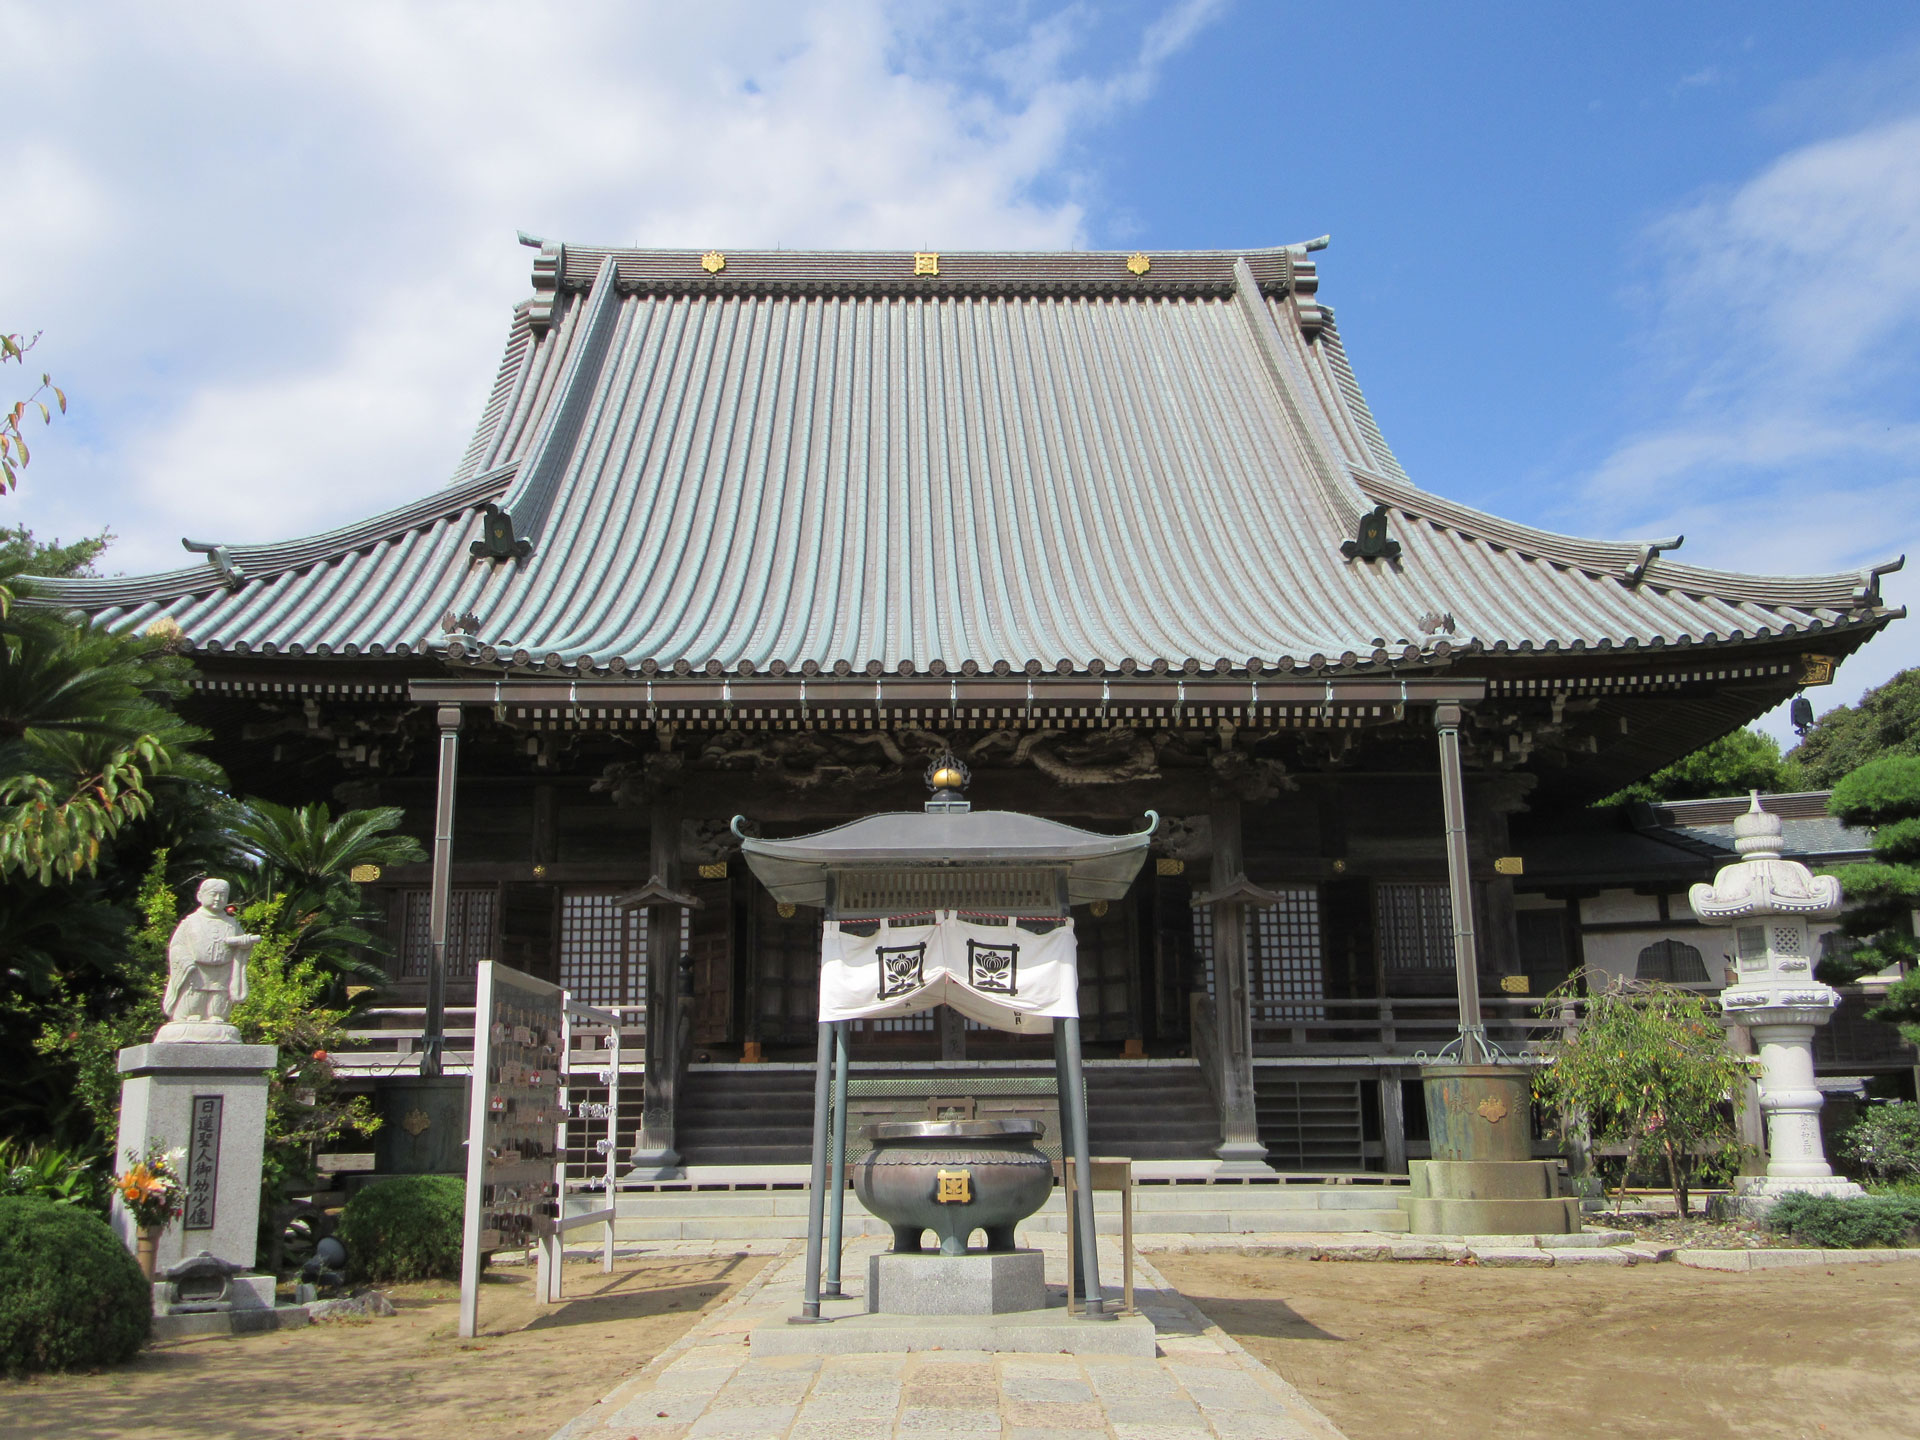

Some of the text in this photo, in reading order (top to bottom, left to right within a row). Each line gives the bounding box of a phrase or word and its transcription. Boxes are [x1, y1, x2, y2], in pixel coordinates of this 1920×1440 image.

[188, 1100, 215, 1225] 日蓮聖人御幼少像
